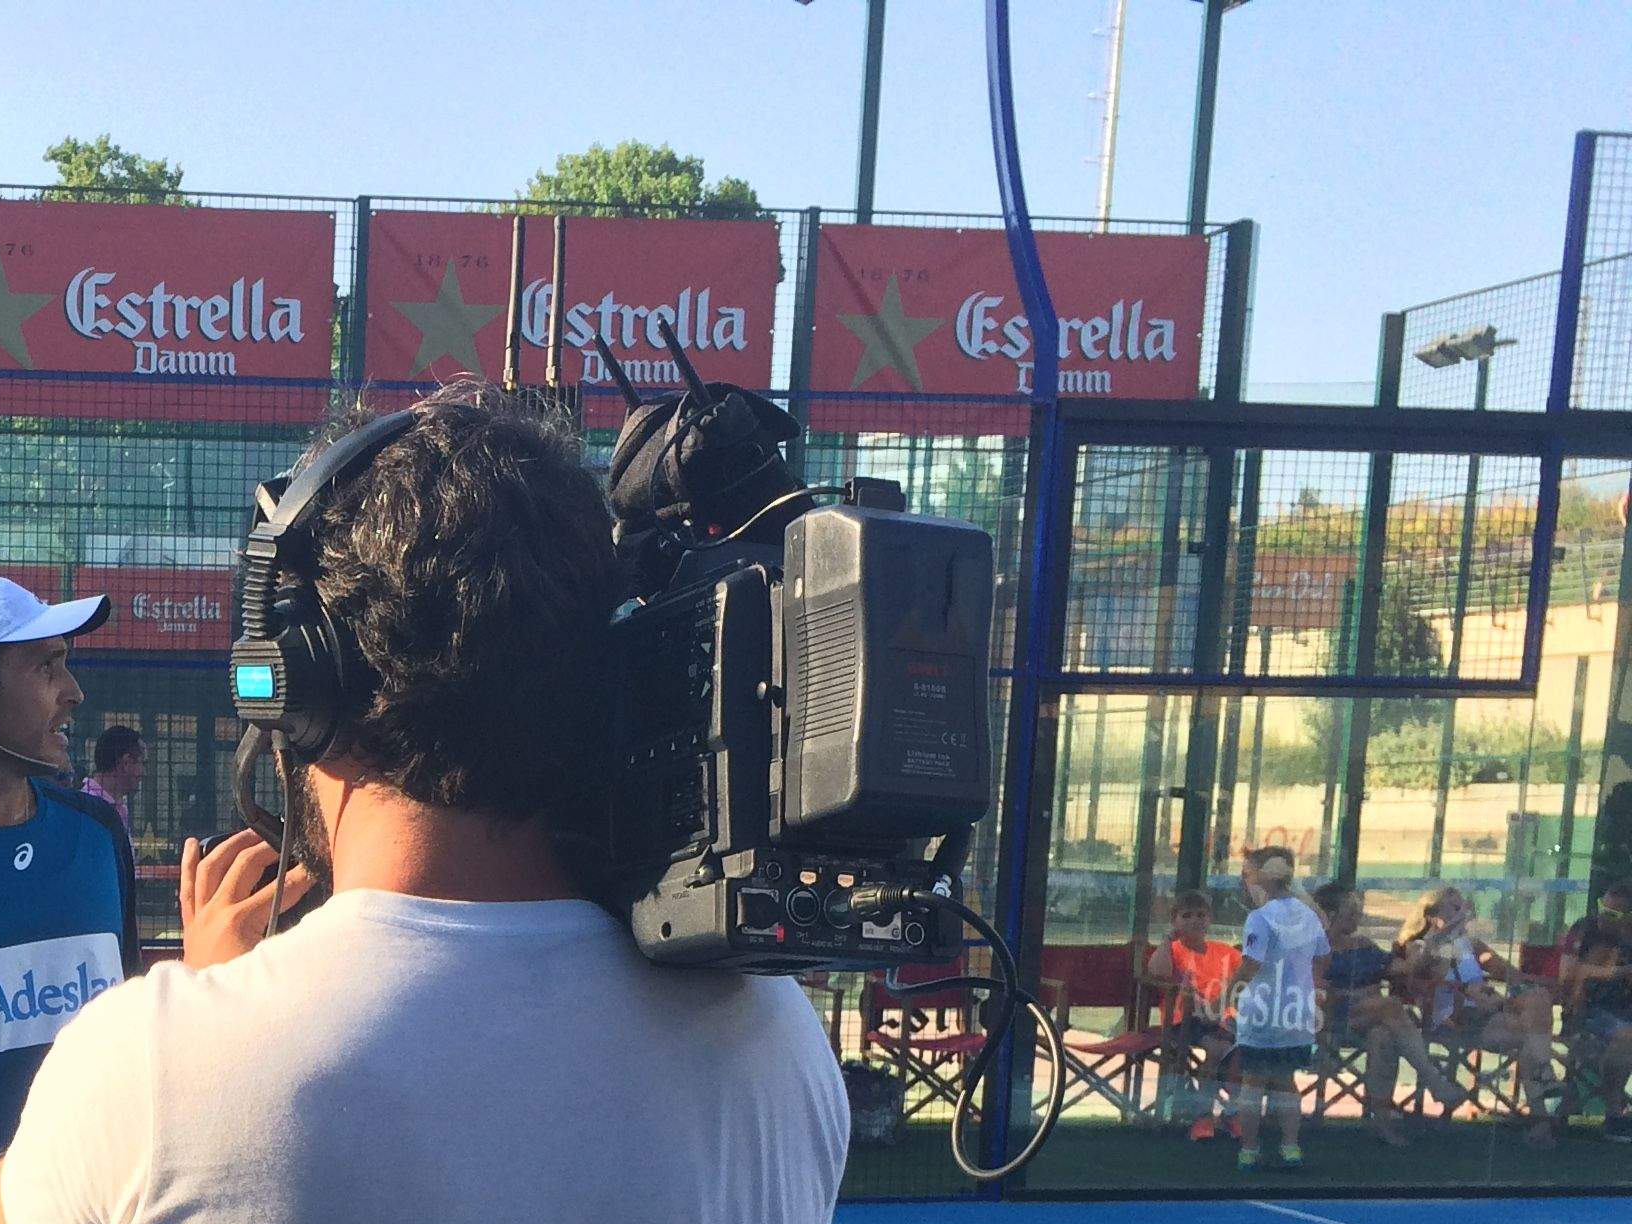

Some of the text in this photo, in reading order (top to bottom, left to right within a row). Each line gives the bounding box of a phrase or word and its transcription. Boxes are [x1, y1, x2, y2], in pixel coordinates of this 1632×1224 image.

[65, 266, 306, 344] Estrella
[955, 290, 1178, 361] Esrella
[132, 340, 237, 376] Damm
[581, 349, 681, 384] Dmm
[1016, 361, 1112, 395] Dmm
[132, 592, 222, 620] Estrella
